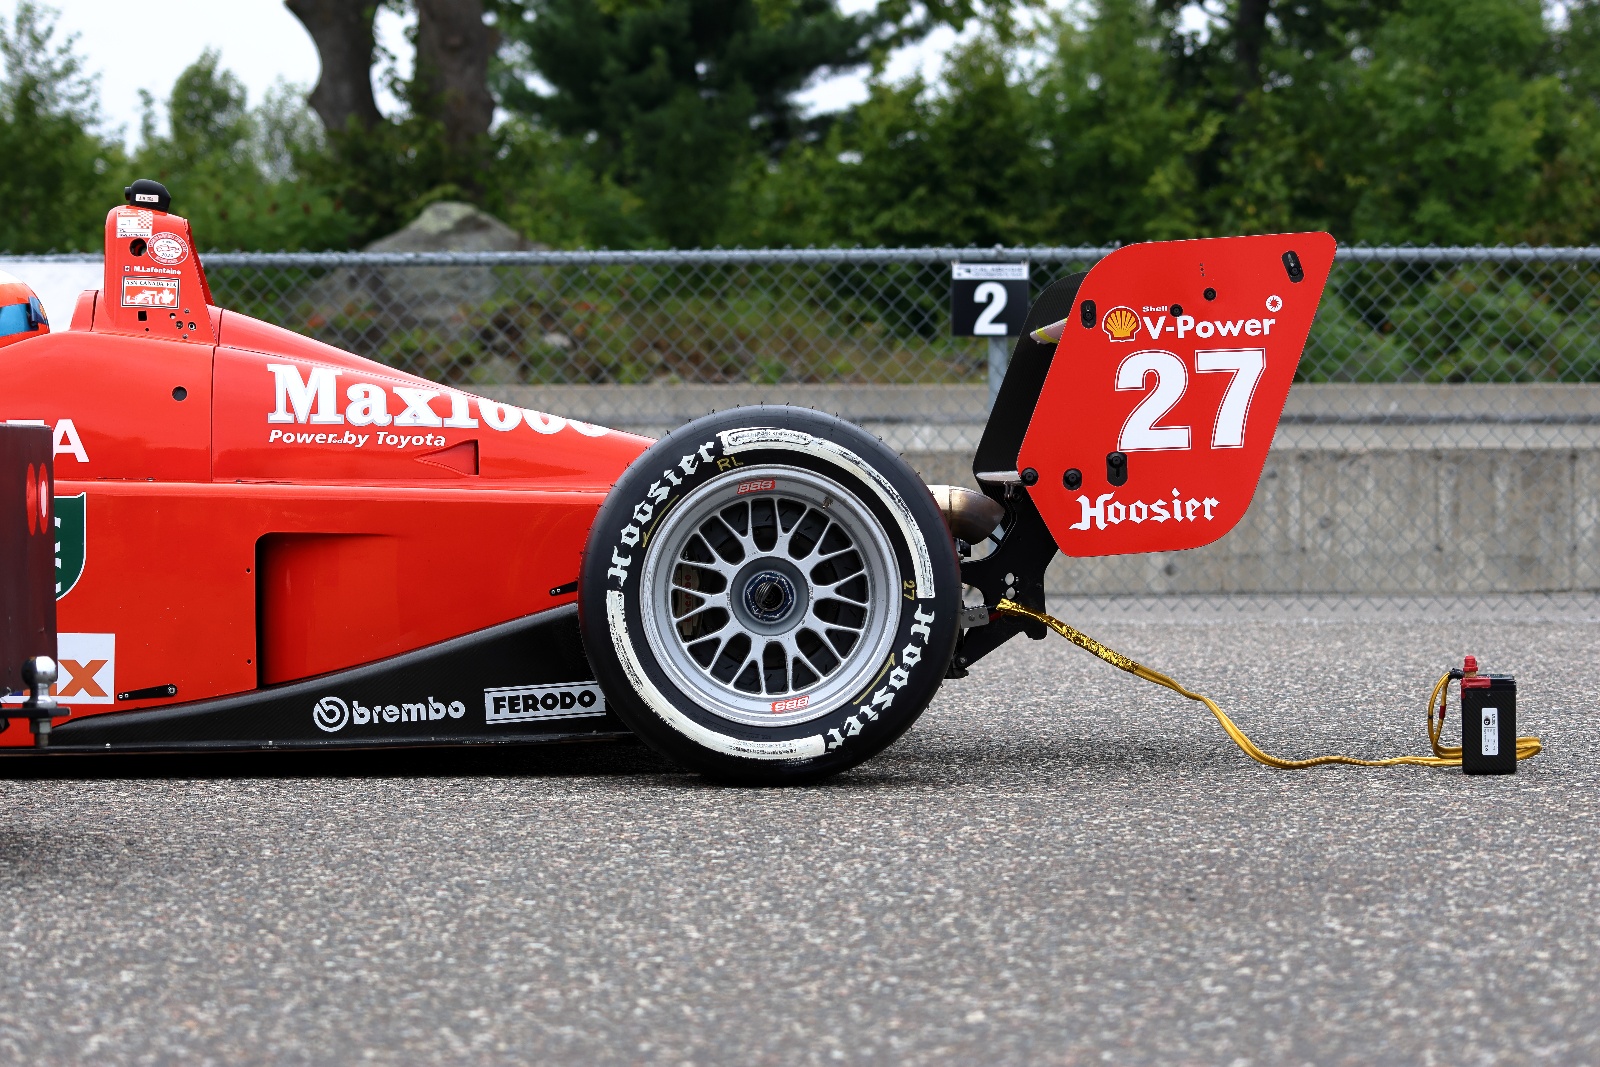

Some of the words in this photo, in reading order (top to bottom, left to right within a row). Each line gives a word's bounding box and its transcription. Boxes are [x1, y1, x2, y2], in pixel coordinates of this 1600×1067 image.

[133, 265, 182, 275] M.Lafontaine
[973, 281, 1008, 335] 2
[1142, 305, 1168, 313] Shell
[1143, 315, 1276, 340] V-Power
[1114, 347, 1267, 452] 27
[376, 431, 446, 449] Toyota
[716, 456, 744, 471] RL
[737, 479, 776, 495] BBS
[606, 441, 715, 588] Hoosier
[1069, 487, 1220, 531] Hoosier
[904, 580, 915, 600] 27
[826, 603, 935, 750] Hoosier
[353, 696, 466, 725] brembo
[492, 689, 597, 715] FERODO
